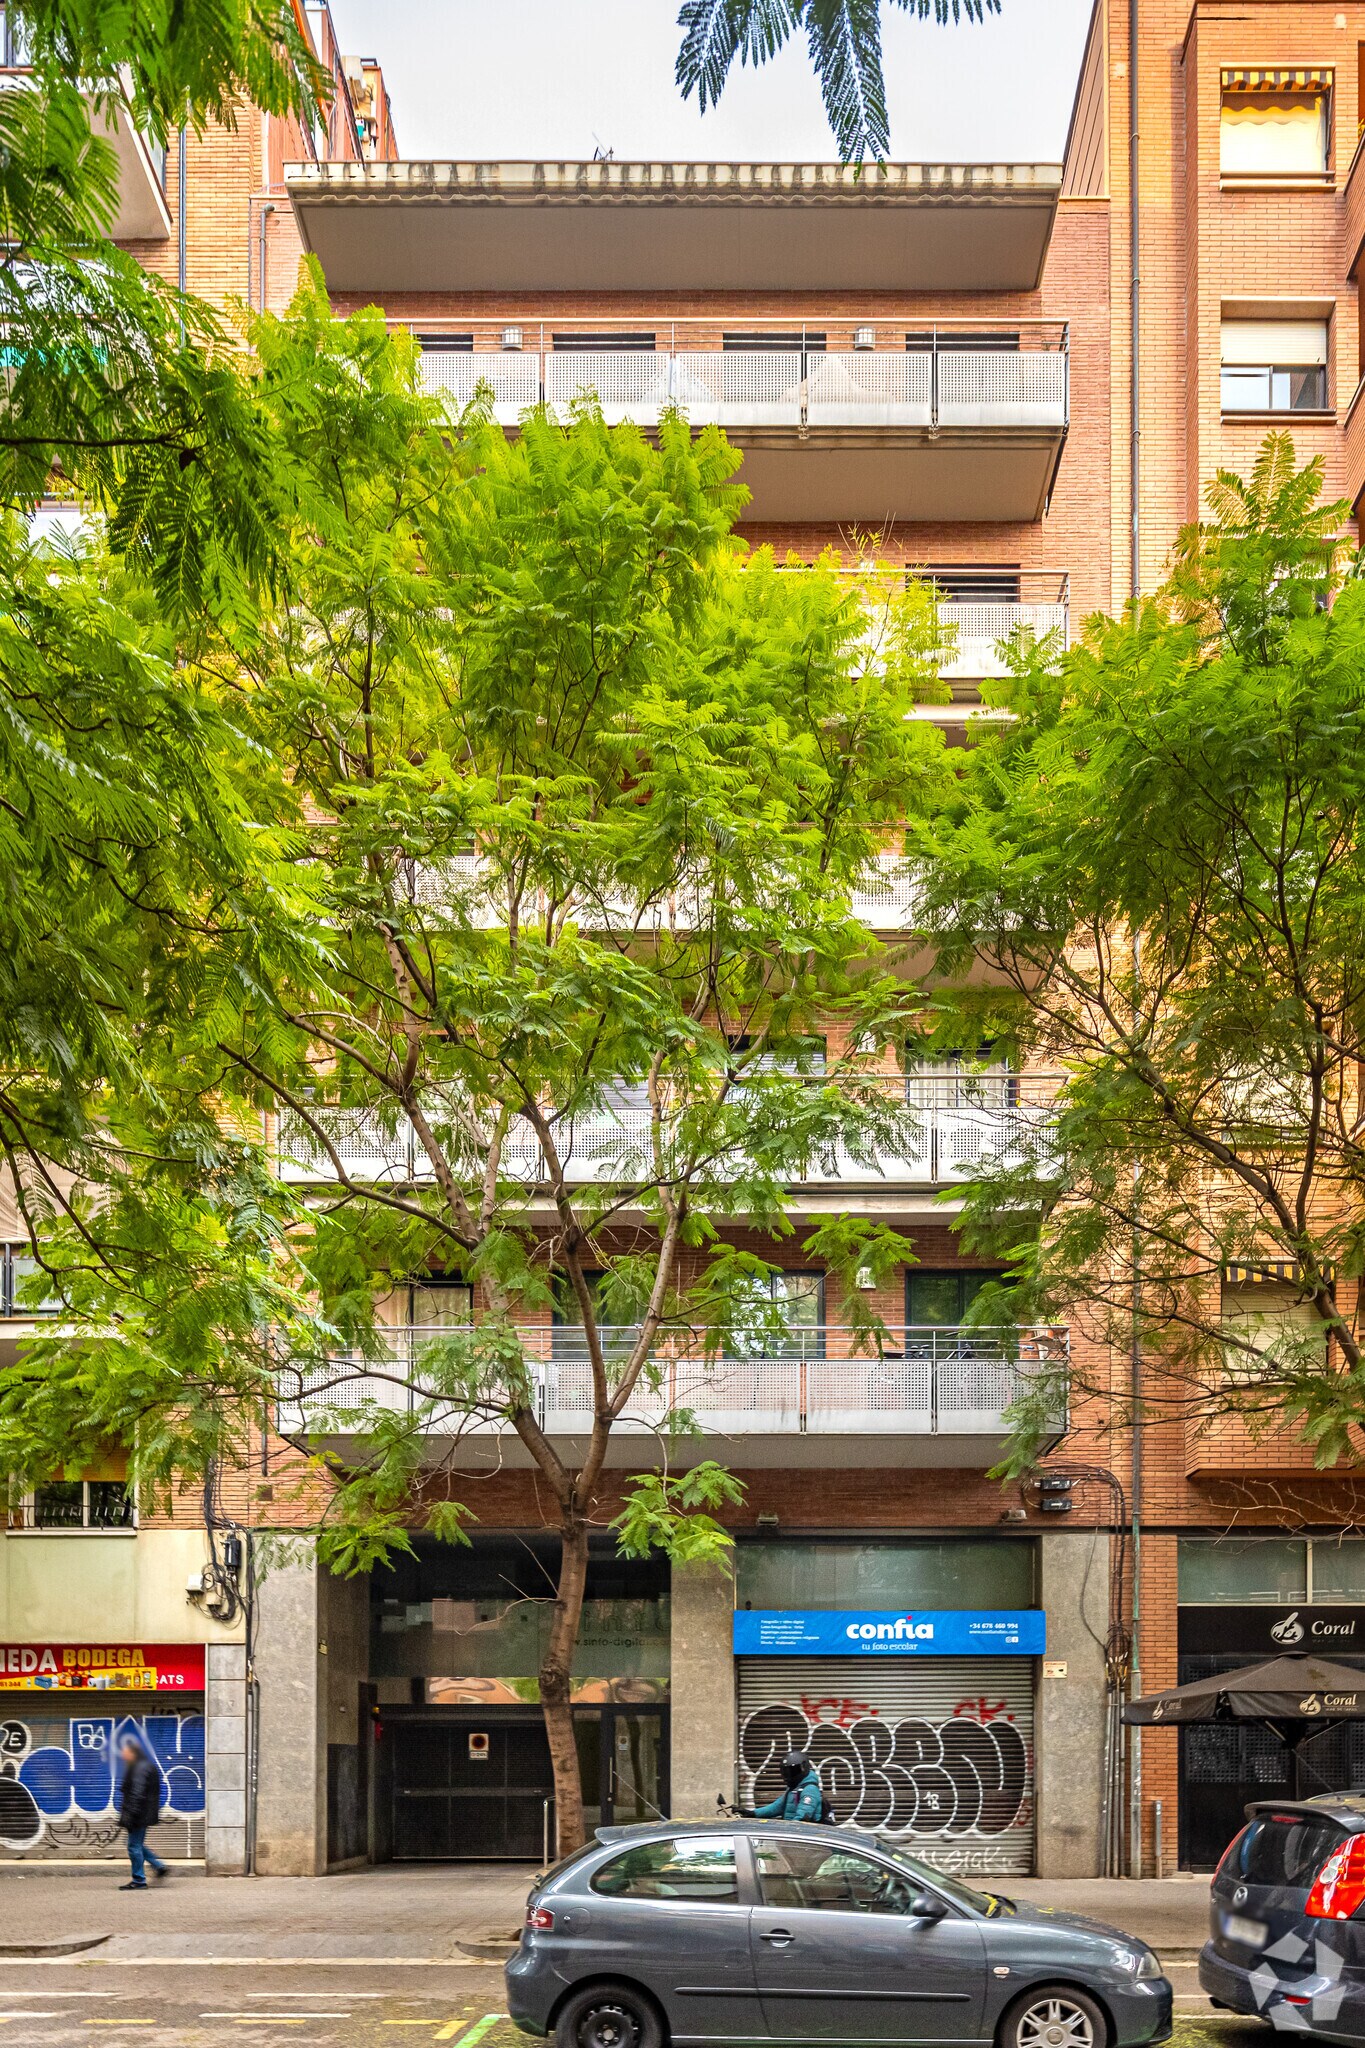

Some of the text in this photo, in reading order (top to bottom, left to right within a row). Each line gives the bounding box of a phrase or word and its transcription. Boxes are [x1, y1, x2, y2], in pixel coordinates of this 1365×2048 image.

[846, 1615, 934, 1639] confia
[1311, 1620, 1356, 1635] Coral
[62, 1649, 146, 1667] BODEGA
[1324, 1693, 1357, 1706] Coral
